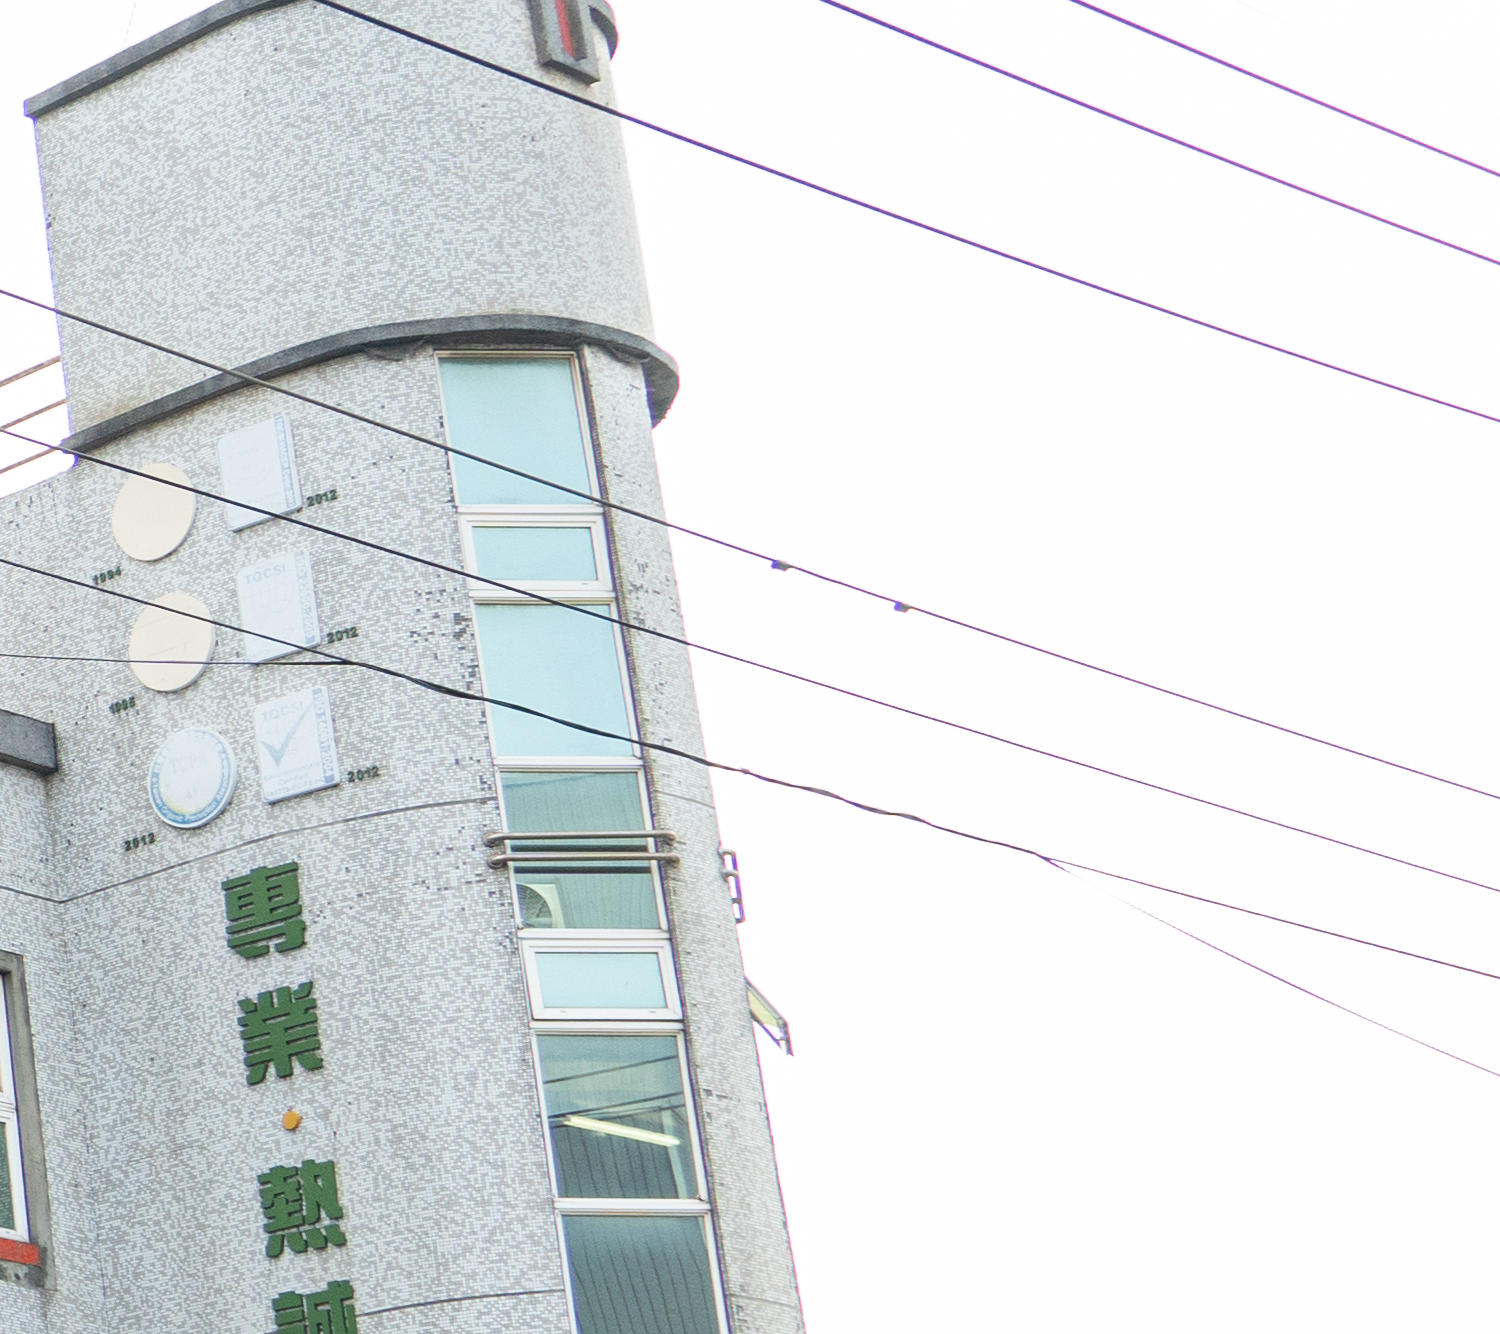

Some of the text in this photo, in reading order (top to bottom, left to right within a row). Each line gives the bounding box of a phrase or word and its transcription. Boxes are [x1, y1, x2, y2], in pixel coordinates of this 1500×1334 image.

[306, 489, 338, 508] 2012
[326, 626, 360, 644] 2012
[346, 766, 380, 783] 2012
[124, 832, 156, 852] 2012
